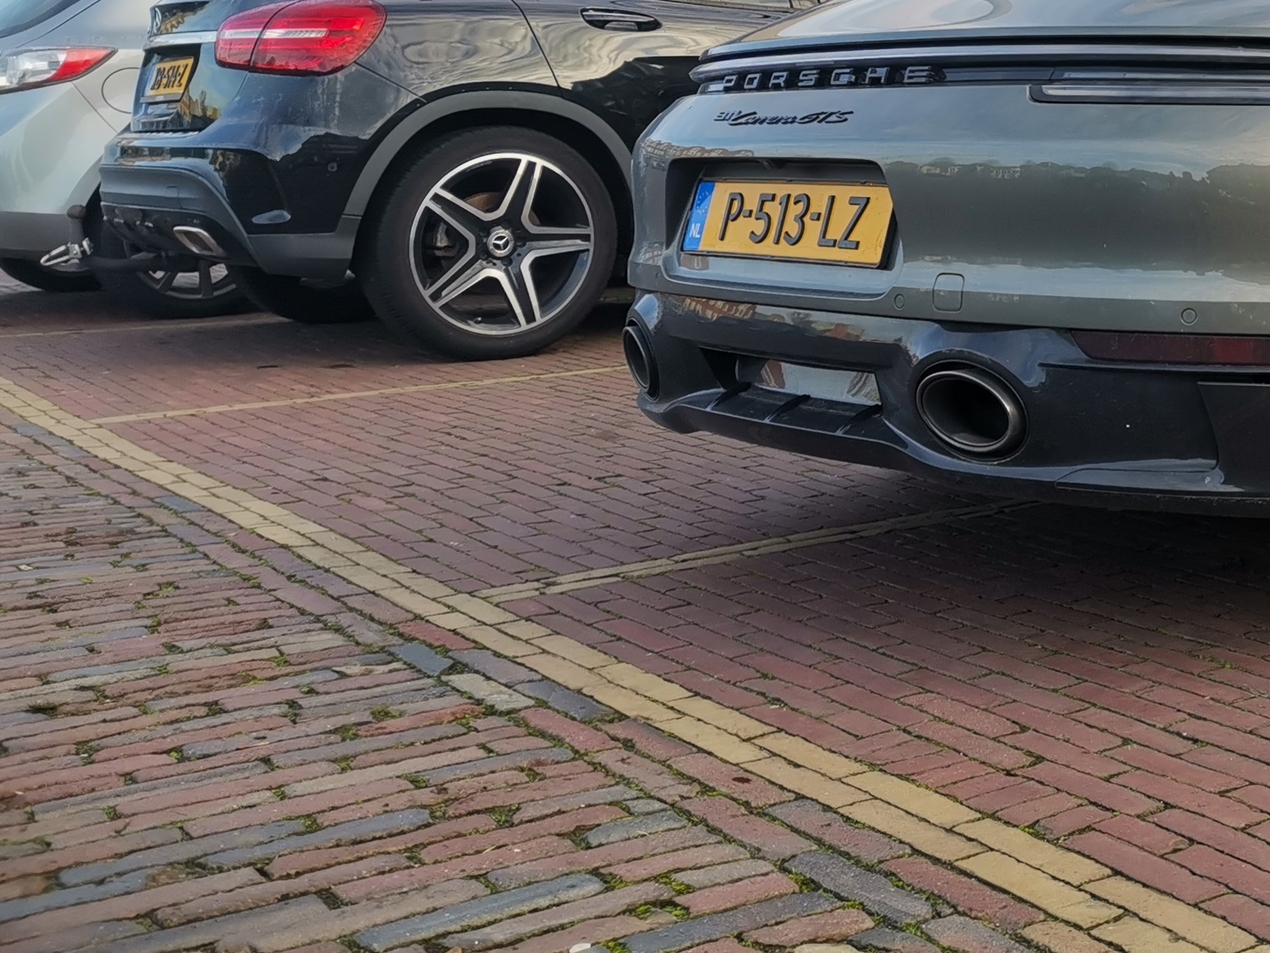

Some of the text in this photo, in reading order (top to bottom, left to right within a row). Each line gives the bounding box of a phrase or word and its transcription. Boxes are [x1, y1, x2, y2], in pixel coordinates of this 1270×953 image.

[723, 66, 932, 89] PORSCHE
[797, 110, 854, 125] GTS
[689, 223, 701, 238] NL
[718, 192, 871, 250] P-513-LZ
